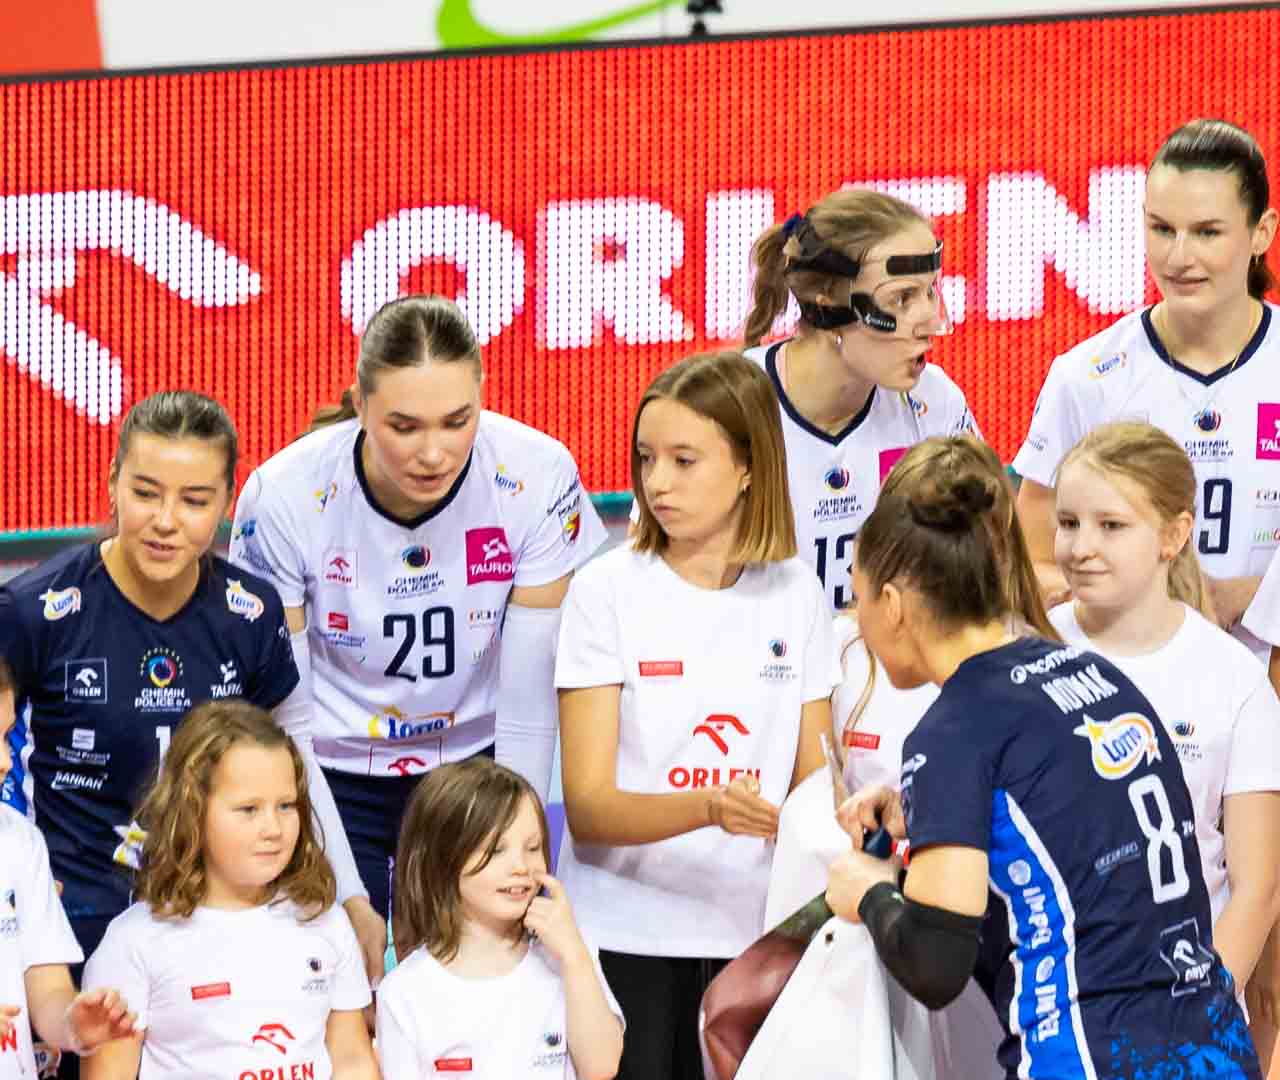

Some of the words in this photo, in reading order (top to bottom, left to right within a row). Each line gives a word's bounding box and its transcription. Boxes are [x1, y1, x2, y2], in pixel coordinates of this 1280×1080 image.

[383, 605, 456, 682] 29
[73, 687, 101, 697] ORLEN
[134, 697, 172, 707] POLICE
[141, 687, 185, 698] CHEMIK
[1041, 663, 1120, 714] NOWAK
[1103, 727, 1142, 763] LOTTO
[1128, 773, 1190, 904] 8
